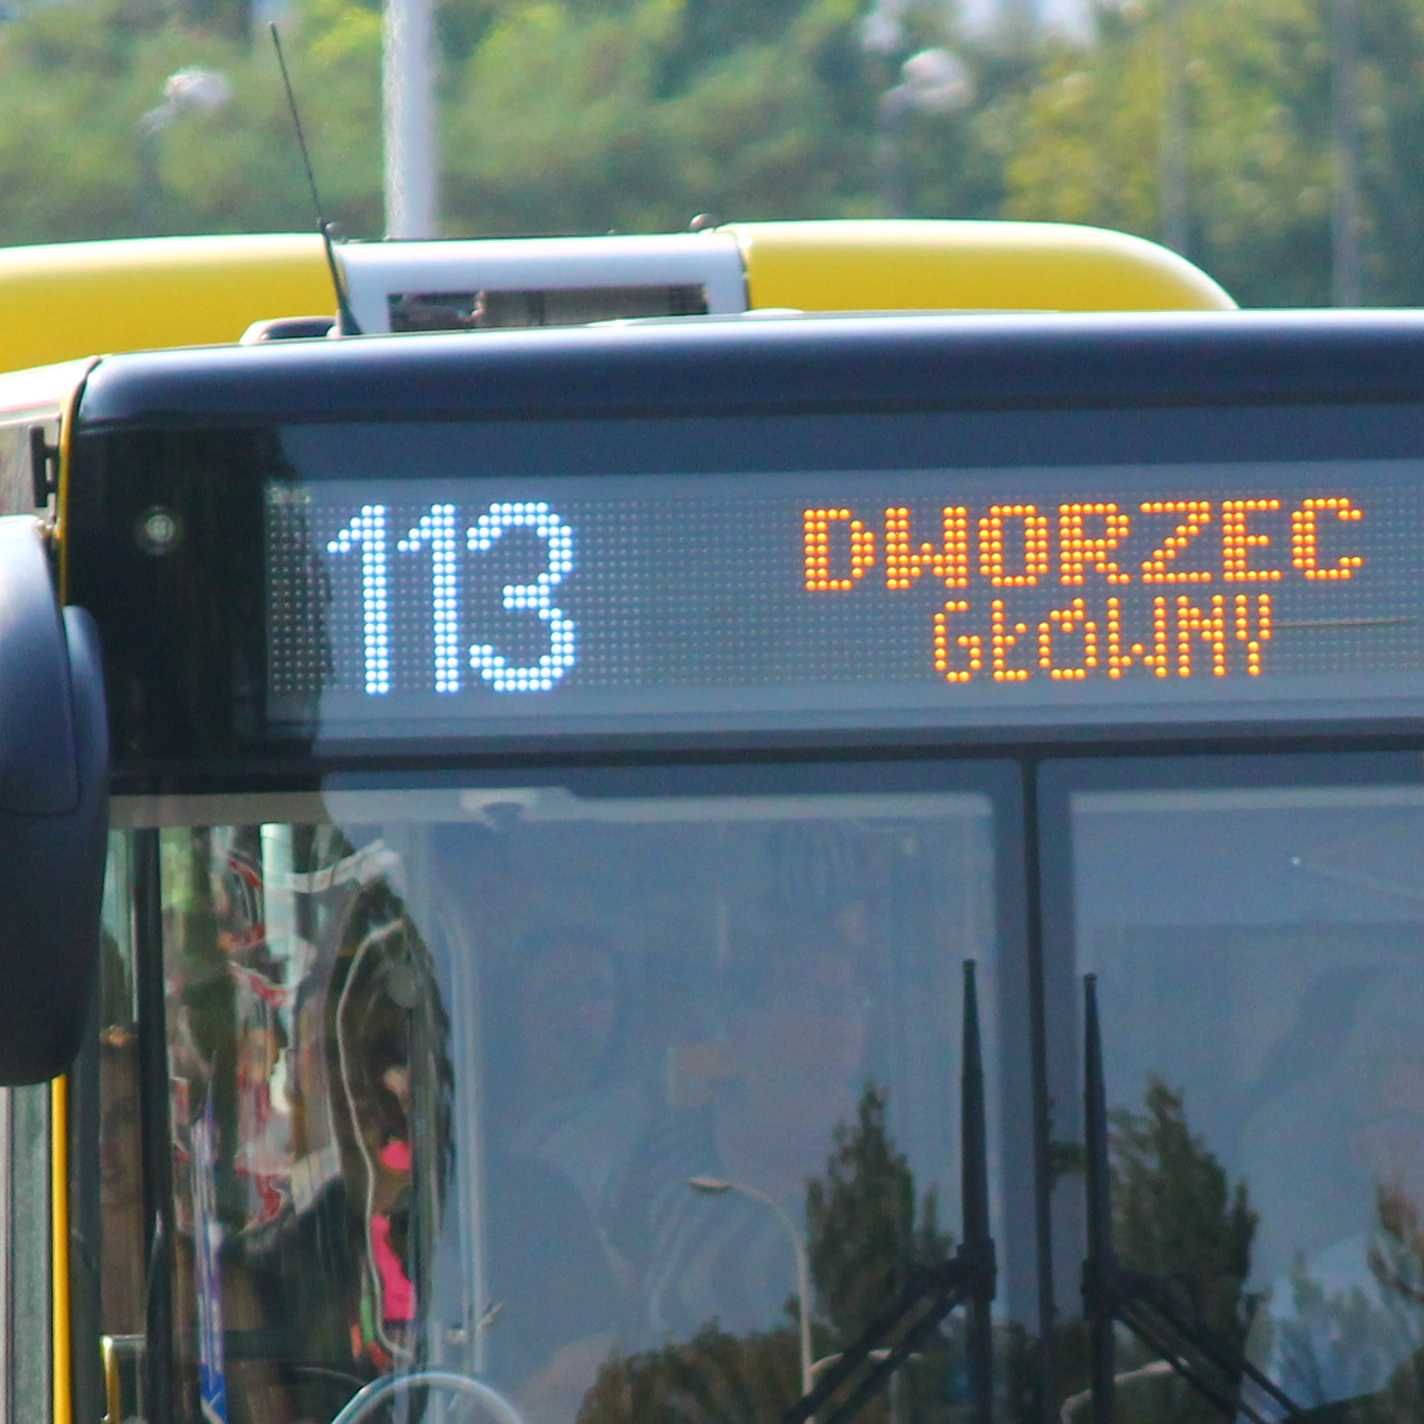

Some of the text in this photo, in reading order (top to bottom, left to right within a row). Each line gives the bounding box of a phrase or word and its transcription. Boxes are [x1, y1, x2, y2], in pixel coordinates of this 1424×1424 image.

[327, 497, 1364, 693] 113 DWORZEC
[932, 593, 1272, 683] GŁÓWNY
